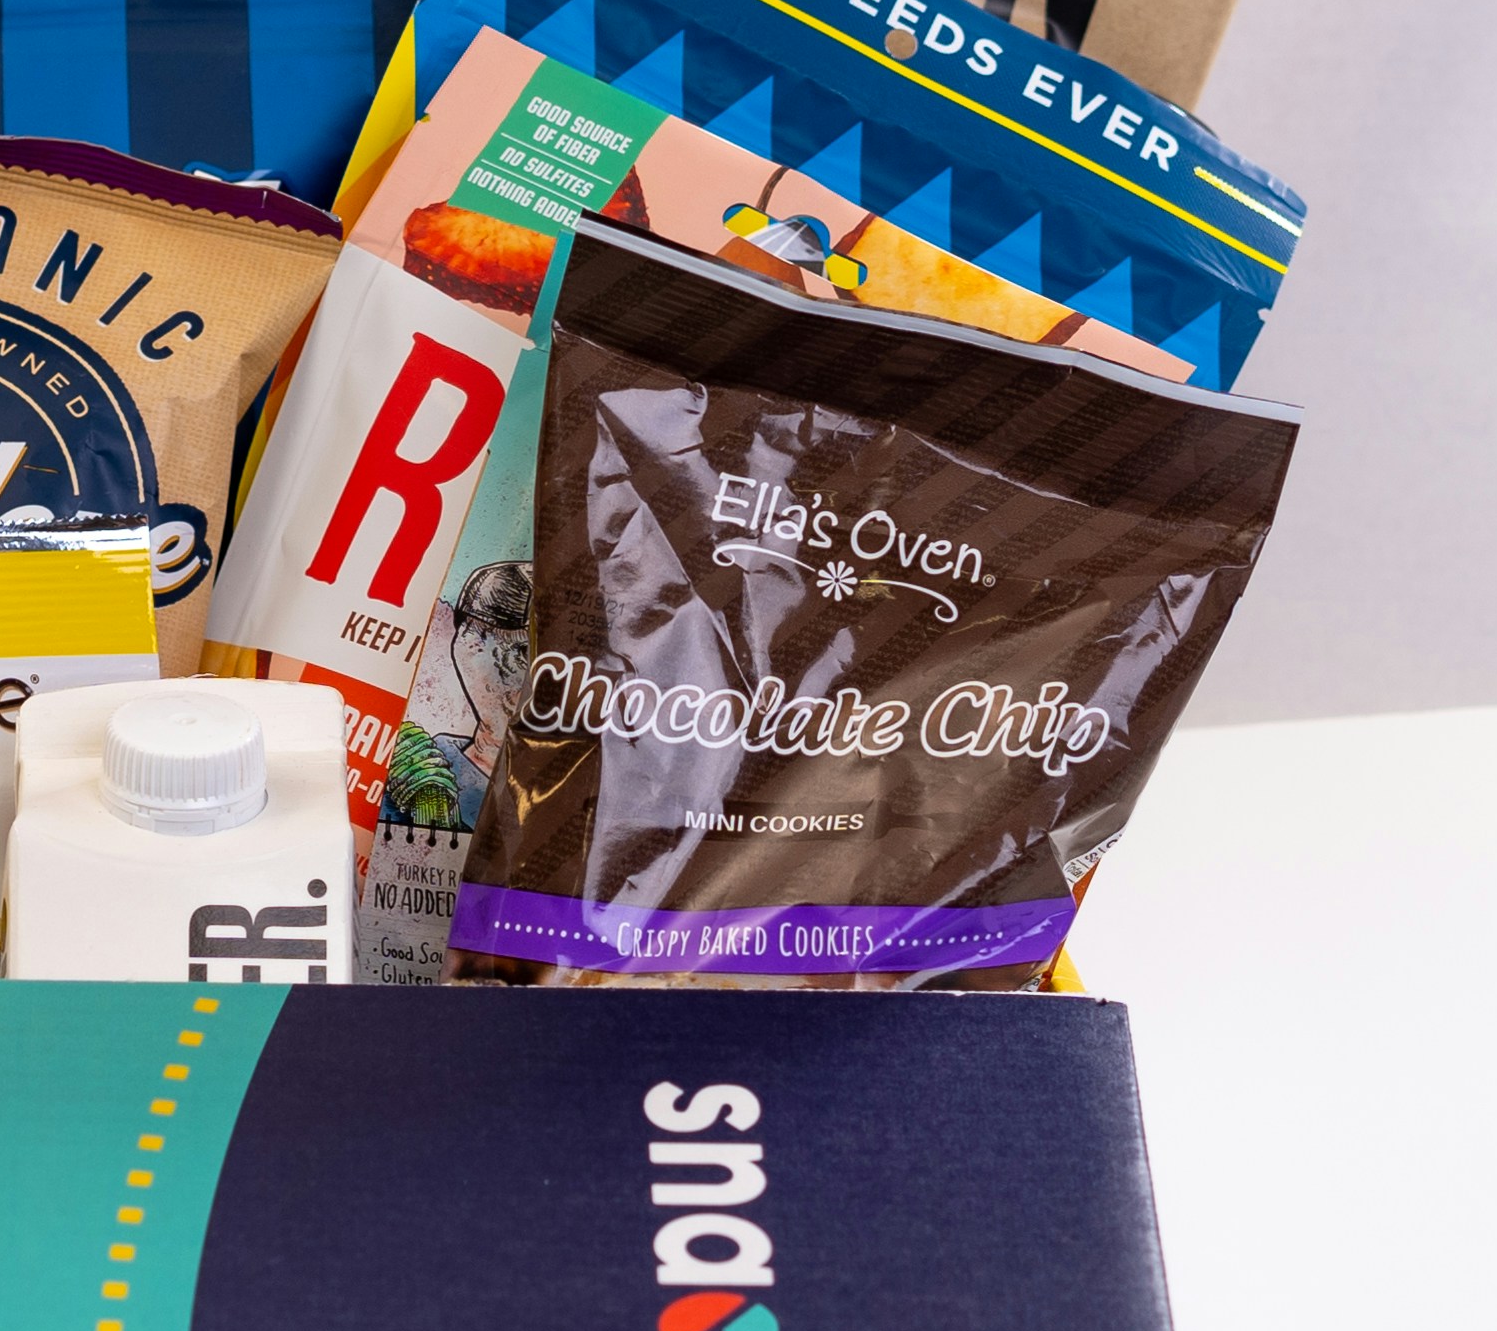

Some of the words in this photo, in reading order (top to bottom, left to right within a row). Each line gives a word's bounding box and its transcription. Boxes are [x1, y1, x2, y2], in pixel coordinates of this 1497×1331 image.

[526, 96, 572, 127] GOOD
[569, 116, 633, 154] SOURCE
[1022, 64, 1180, 172] EVER
[532, 124, 557, 145] OF
[554, 137, 601, 165] FIBER
[467, 167, 536, 207] NOTHING
[499, 147, 526, 166] NO
[523, 157, 594, 198] SULFITES
[711, 471, 836, 550] Ella's
[850, 510, 984, 584] Oven
[341, 611, 405, 654] KEEP
[520, 652, 903, 757] Chocolate
[921, 682, 1110, 777] Chip
[684, 809, 744, 832] MINI
[749, 812, 864, 834] COOKIES
[396, 862, 445, 886] TURKEY
[374, 882, 396, 910] NO
[400, 883, 456, 918] ADDED
[380, 937, 414, 962] Good
